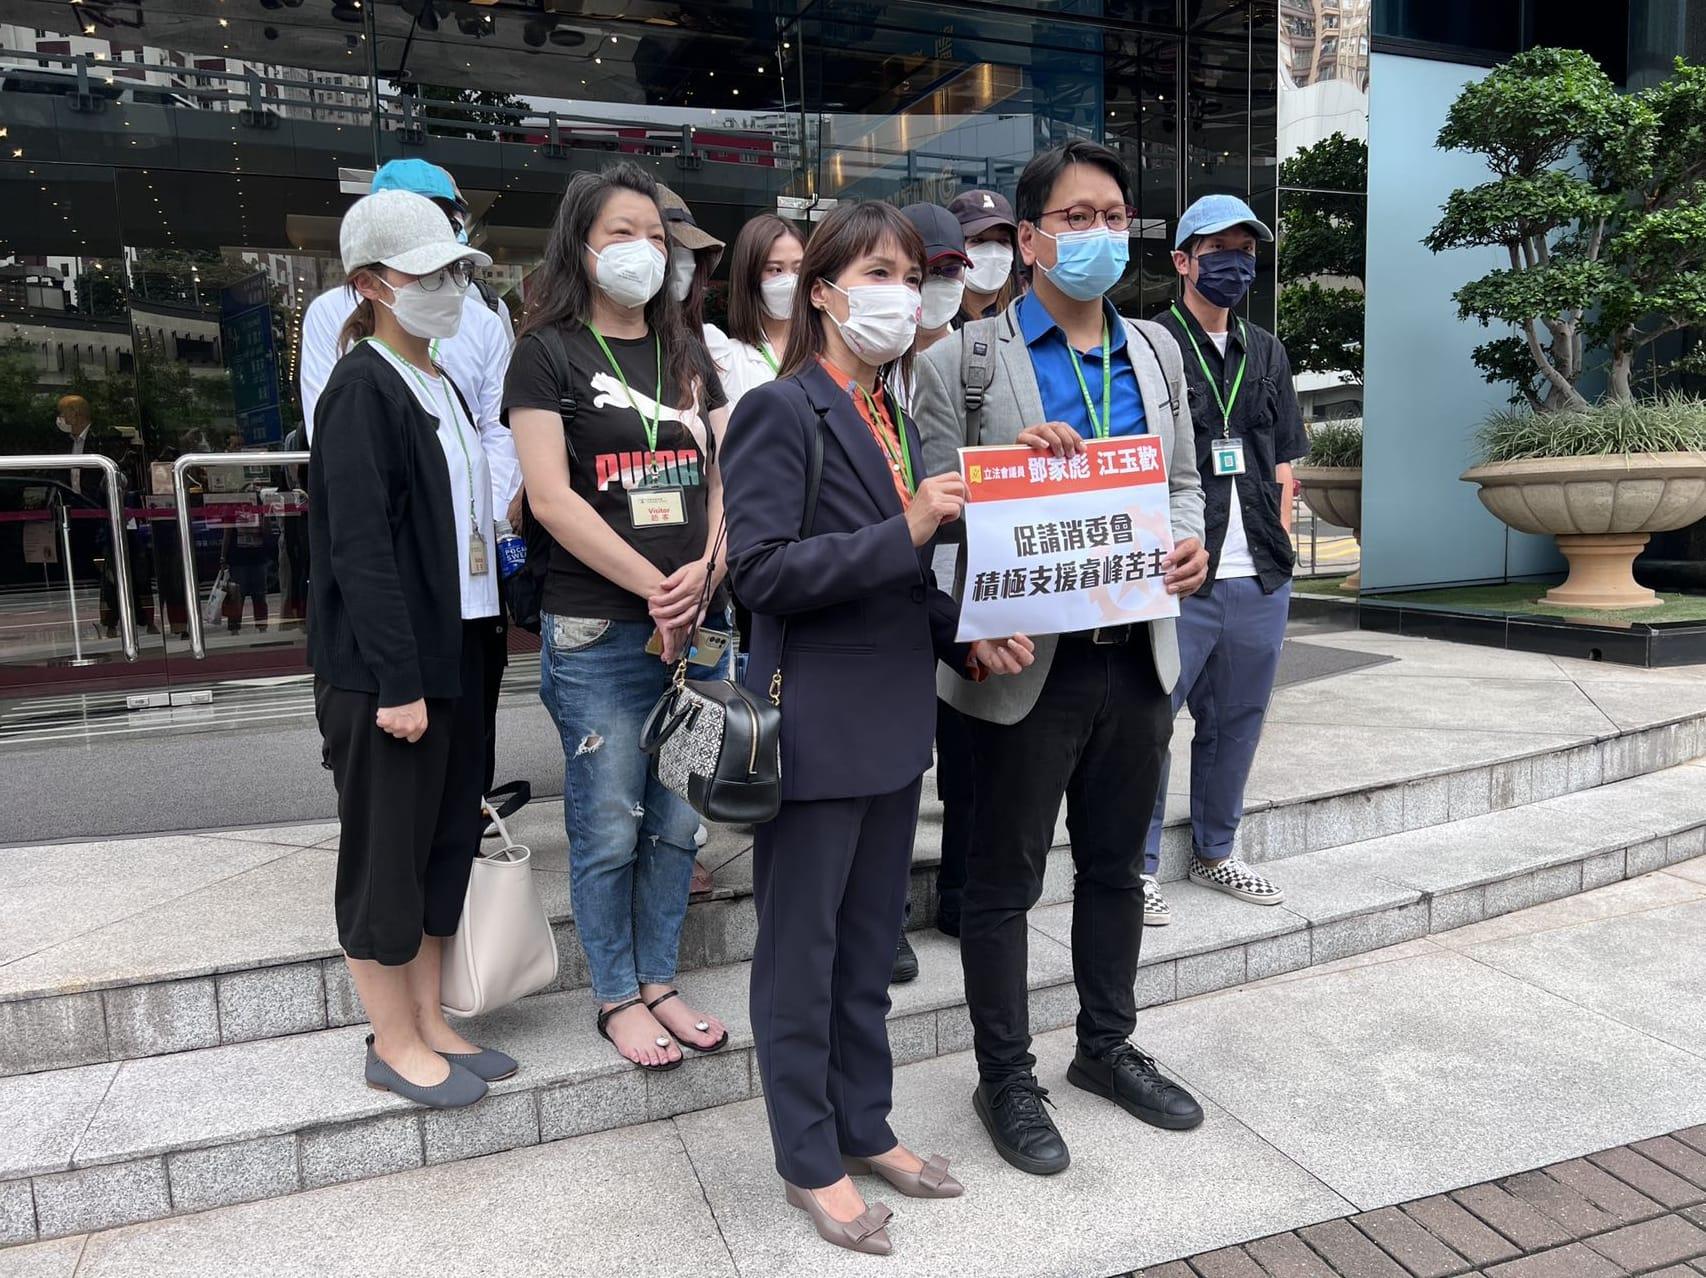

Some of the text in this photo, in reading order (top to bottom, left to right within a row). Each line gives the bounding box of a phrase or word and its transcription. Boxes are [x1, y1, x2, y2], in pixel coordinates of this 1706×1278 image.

[595, 449, 699, 491] PUMA
[984, 465, 1026, 481] 立法會議員
[1096, 445, 1159, 477] 江玉歡
[1013, 513, 1133, 557] 促請消委會
[972, 547, 1168, 603] 積極支援睿峰苦主
